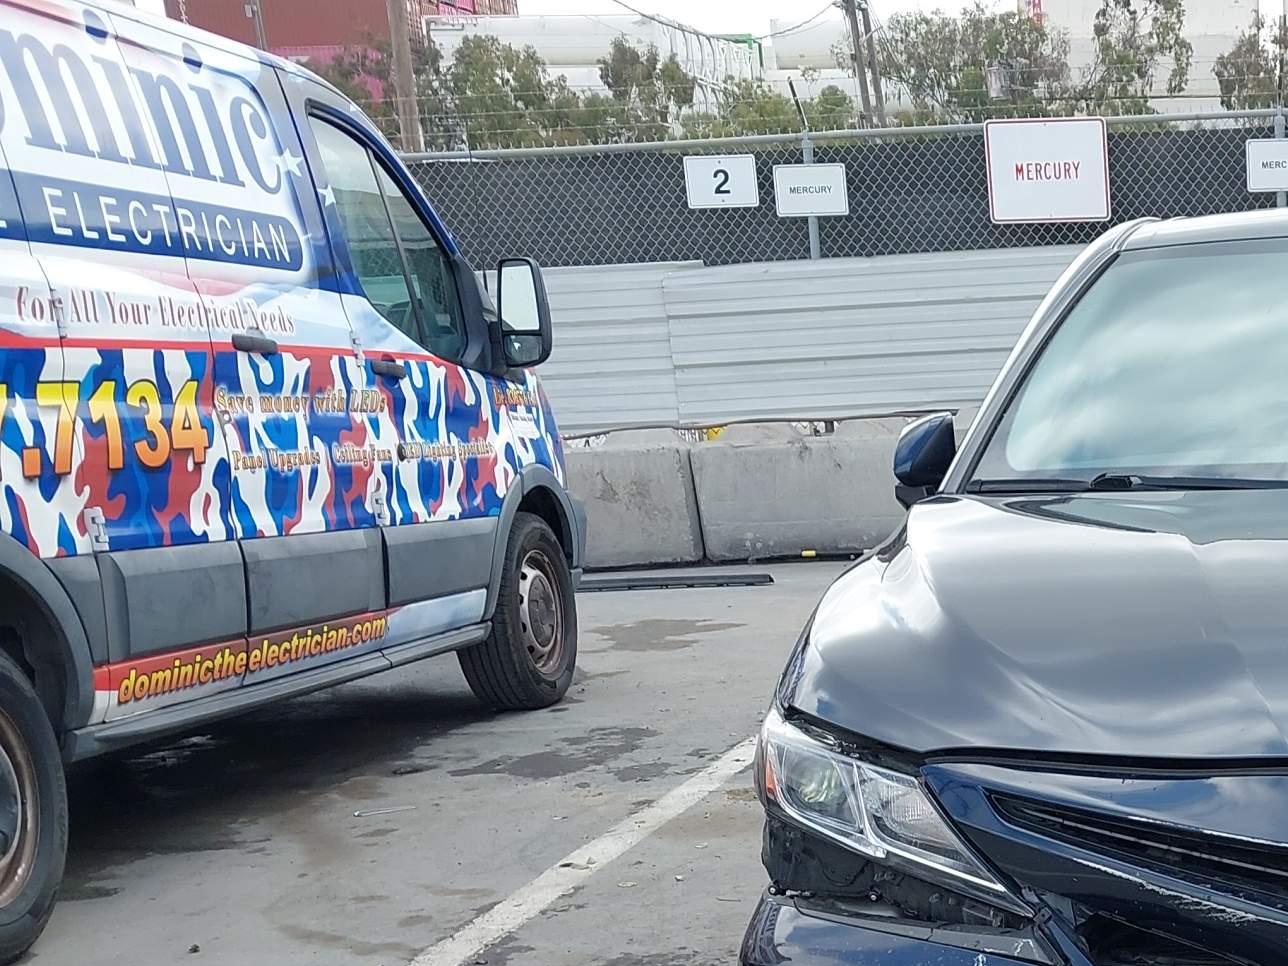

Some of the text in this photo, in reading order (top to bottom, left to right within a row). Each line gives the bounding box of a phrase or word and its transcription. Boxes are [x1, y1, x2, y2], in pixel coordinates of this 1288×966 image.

[0, 9, 281, 194] minic
[713, 168, 731, 194] 2
[789, 186, 832, 194] MERCURY
[1015, 161, 1080, 181] MERCURY
[42, 186, 291, 263] ELECTRICIAN
[16, 286, 295, 334] For All Your Electrical Needs
[216, 388, 386, 420] Save money with LEDs
[0, 379, 210, 479] .7134
[233, 449, 267, 471] Panel
[271, 447, 321, 472] Upgrades
[117, 615, 387, 704] dominictheelectrician.com
